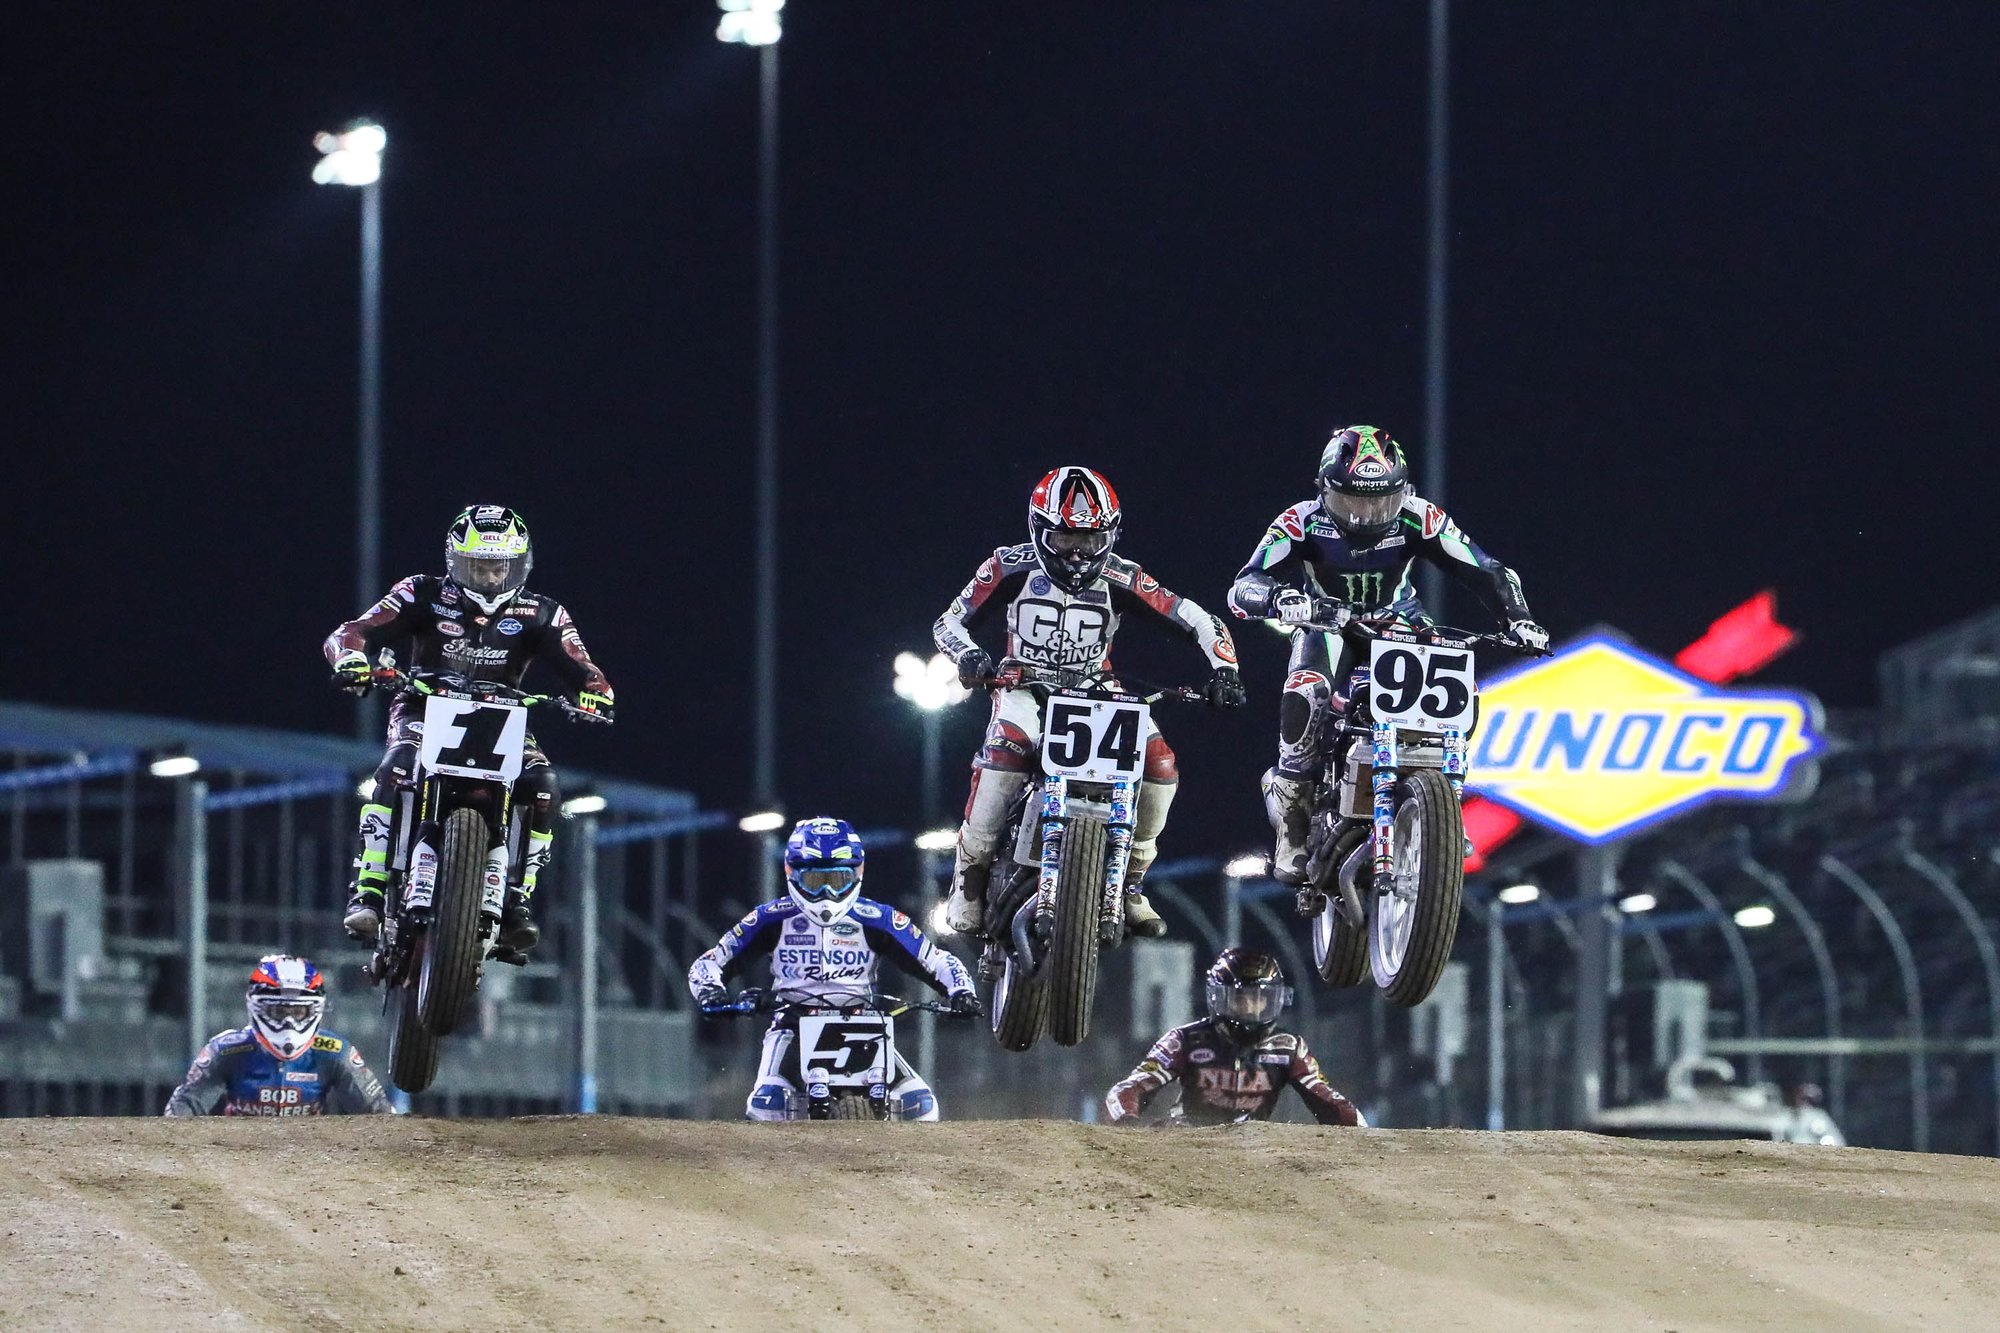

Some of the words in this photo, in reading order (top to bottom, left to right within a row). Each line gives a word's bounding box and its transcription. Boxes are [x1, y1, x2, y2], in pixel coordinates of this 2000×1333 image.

[1359, 464, 1381, 473] Arai
[1352, 480, 1389, 488] MONSTER
[1312, 528, 1333, 537] TEAM
[505, 608, 535, 616] MOTUL
[1018, 600, 1106, 651] G&G
[1022, 641, 1102, 665] RACING
[1374, 649, 1469, 718] 95
[435, 706, 511, 771] 1
[1048, 703, 1141, 772] 54
[1472, 711, 1787, 774] UNOCO
[779, 949, 870, 965] ESTENSON
[804, 966, 865, 981] Racing
[807, 1023, 886, 1075] 5
[260, 1089, 298, 1103] BOB
